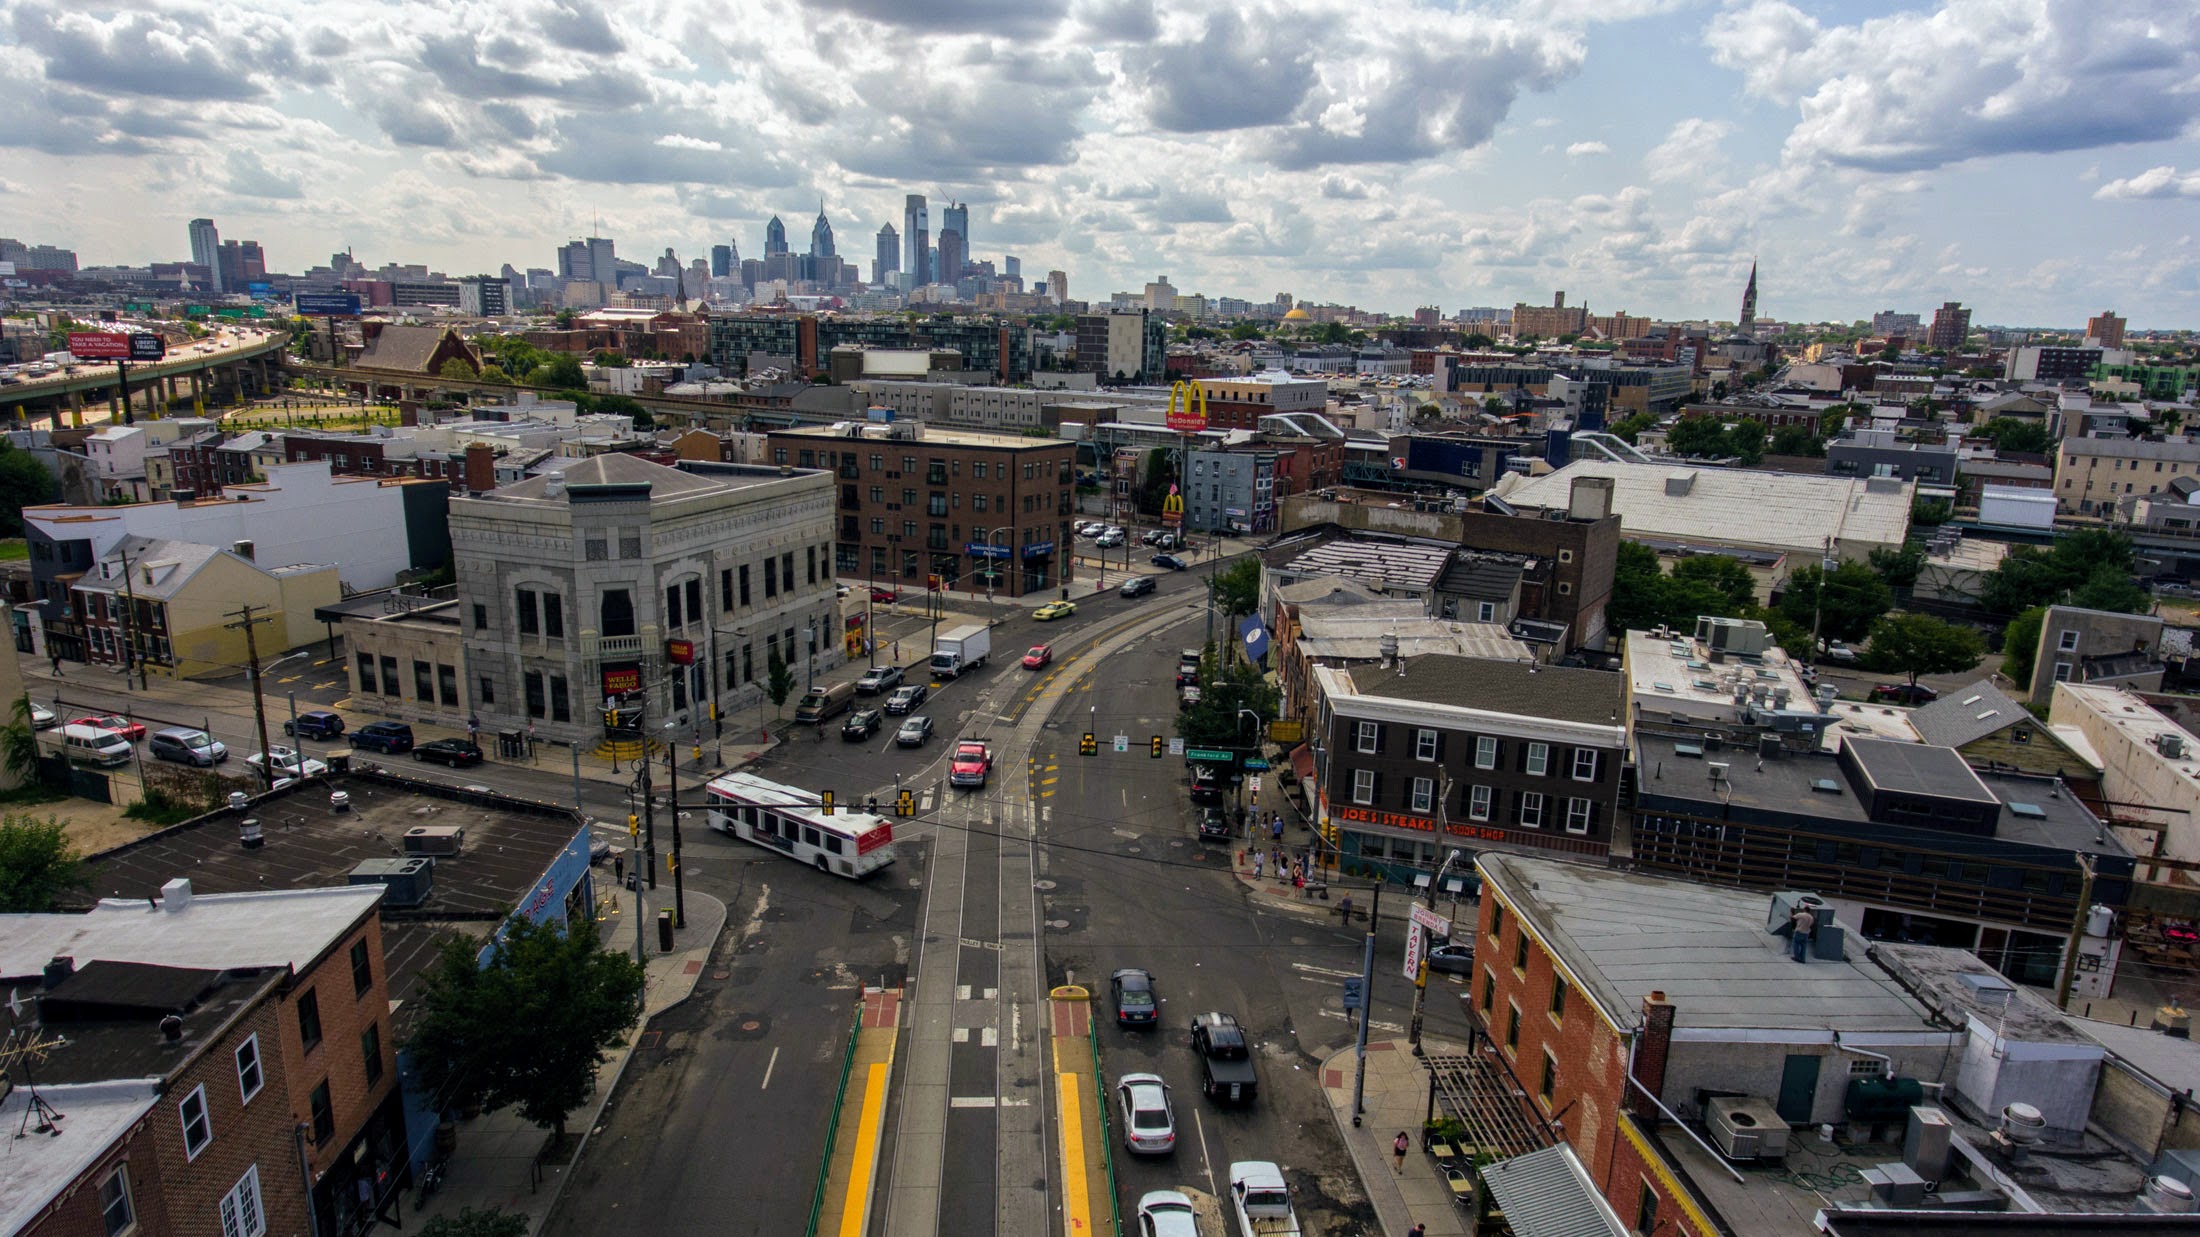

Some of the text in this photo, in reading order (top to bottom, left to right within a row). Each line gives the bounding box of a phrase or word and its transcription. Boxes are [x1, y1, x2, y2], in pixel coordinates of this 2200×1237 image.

[1167, 417, 1206, 425] McDonald's
[608, 674, 636, 683] WELLS
[609, 681, 636, 689] FARGO
[1341, 808, 1433, 831] JOE'S STEAKS
[1480, 828, 1505, 841] SHOP
[1415, 908, 1442, 925] JOHNNY
[1406, 926, 1419, 974] TAVERN
